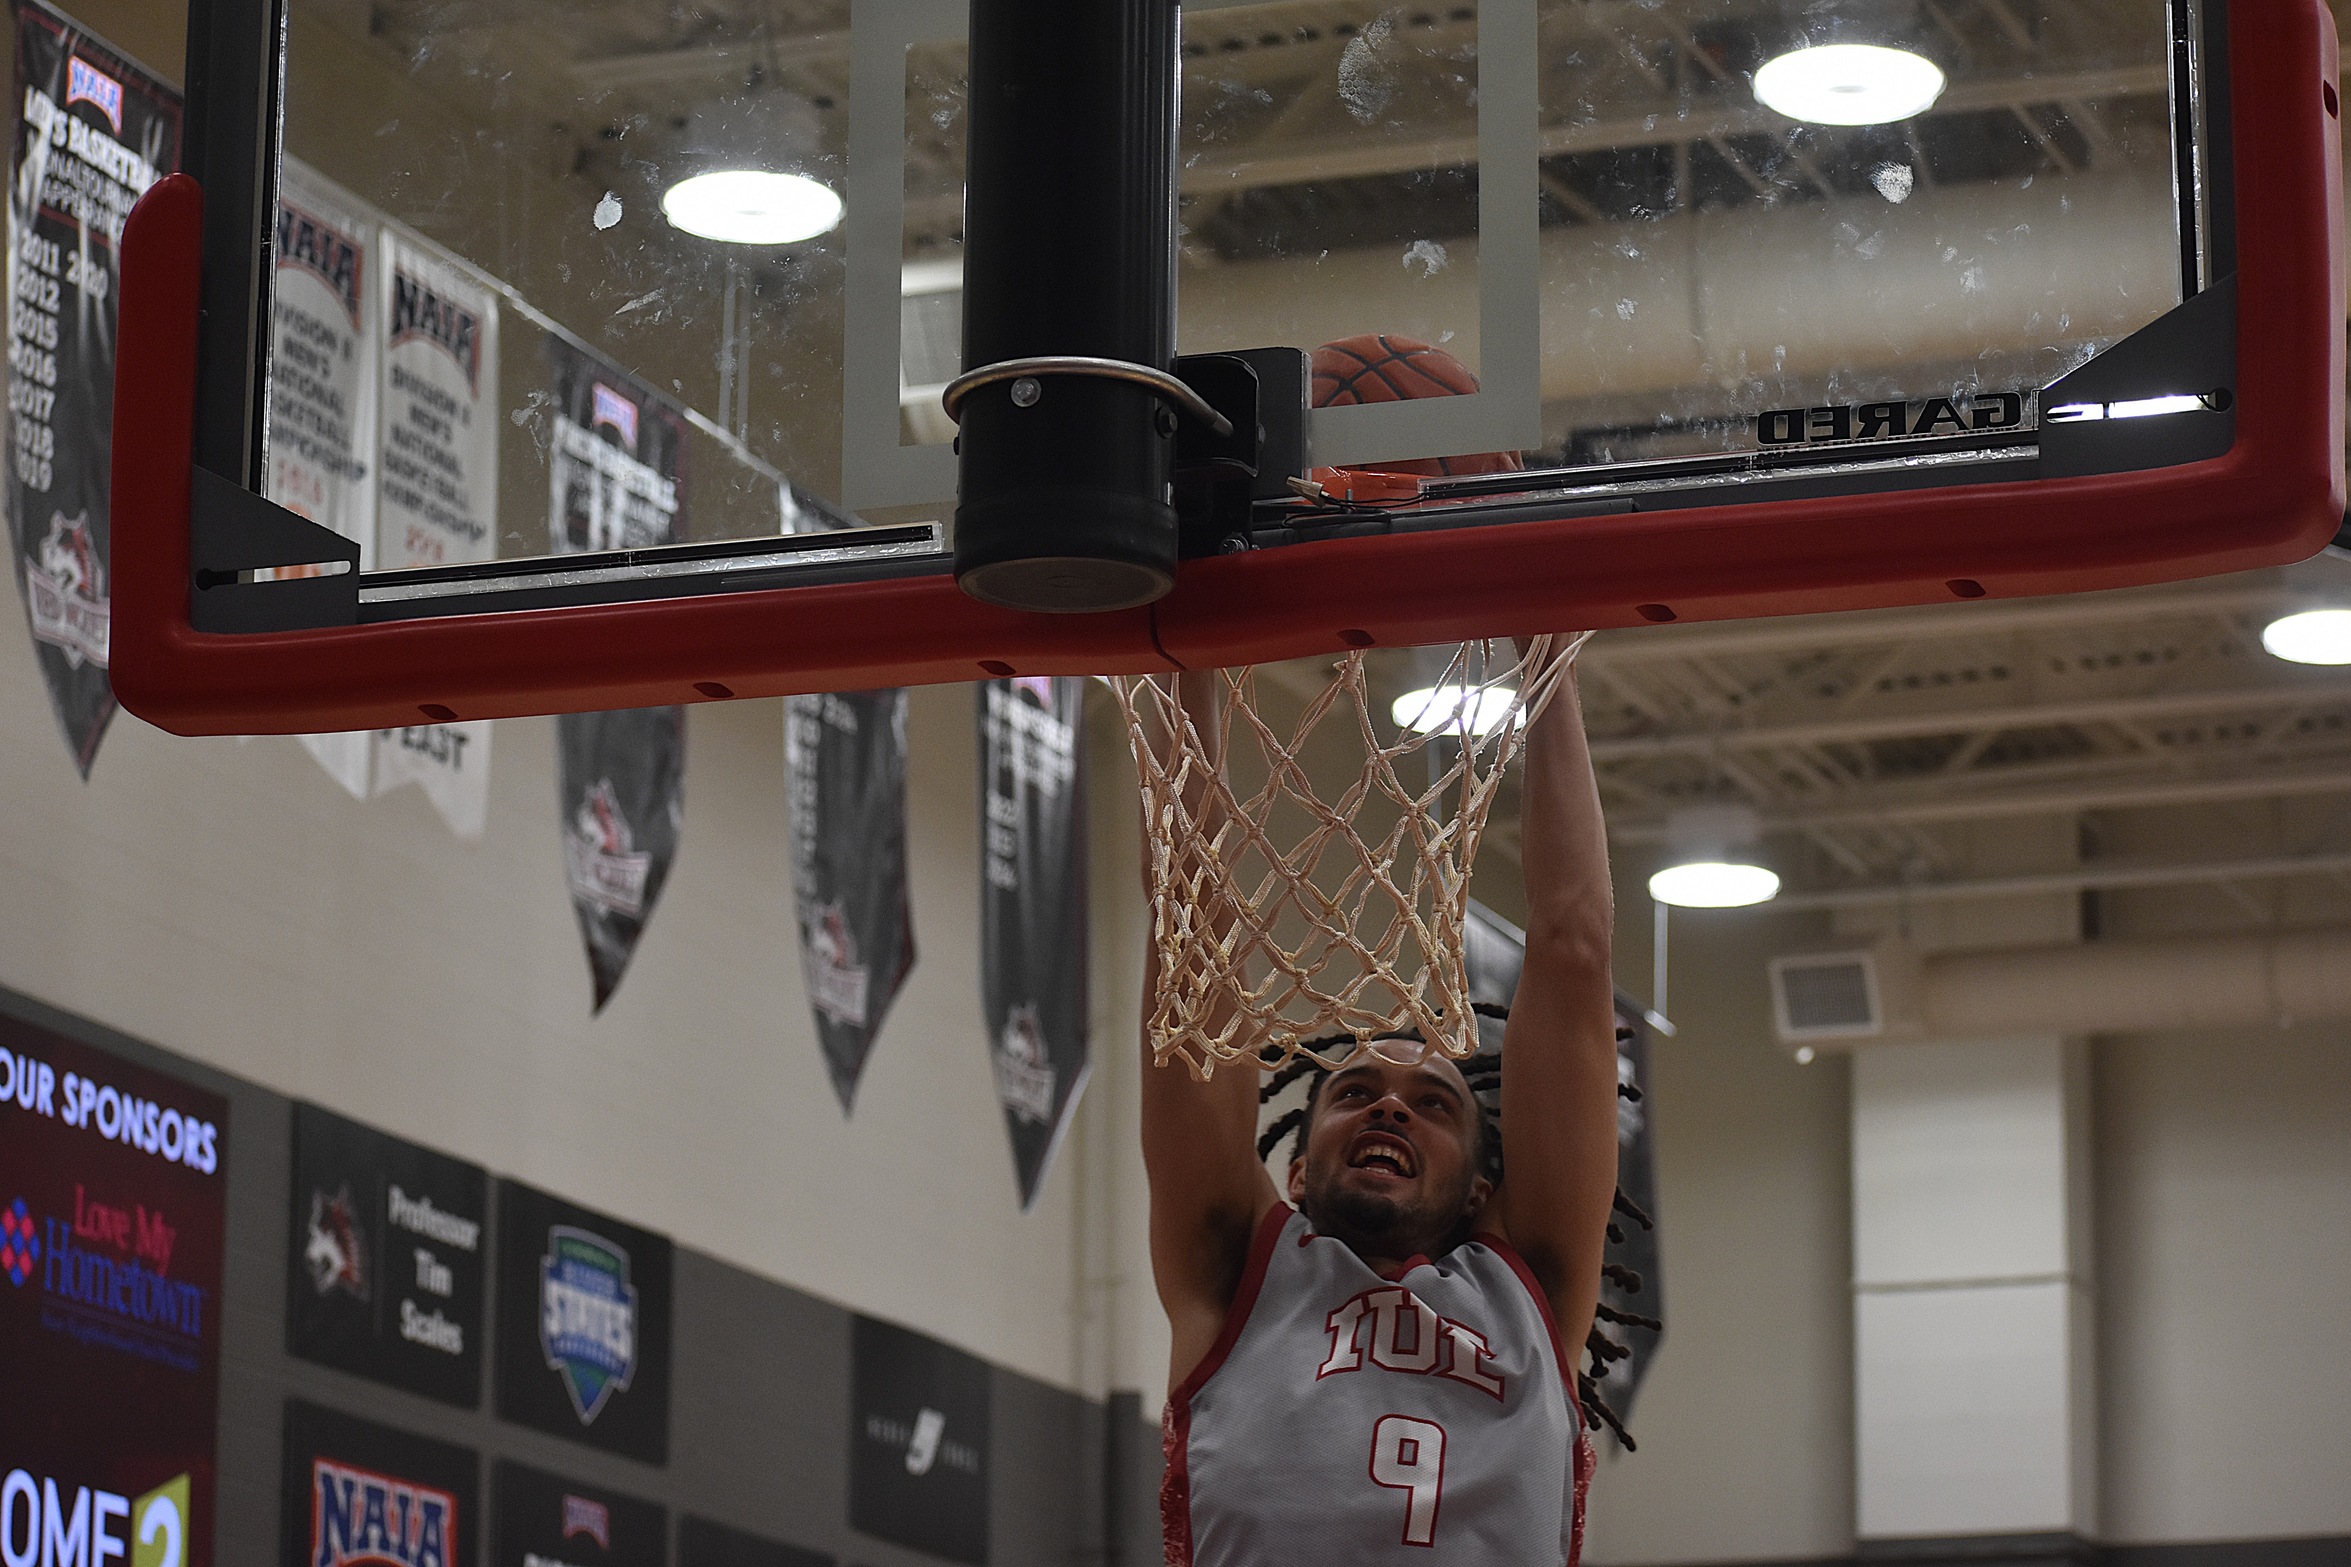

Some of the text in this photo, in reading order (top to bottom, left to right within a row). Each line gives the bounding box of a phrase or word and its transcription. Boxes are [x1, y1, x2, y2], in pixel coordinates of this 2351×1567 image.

[0, 1046, 218, 1175] OUR SPONSORS
[45, 1216, 206, 1338] Hometown
[74, 1182, 176, 1277] Love My
[400, 1298, 463, 1355] Scales
[317, 1468, 447, 1567] NAIA
[1368, 1413, 1447, 1548] 9
